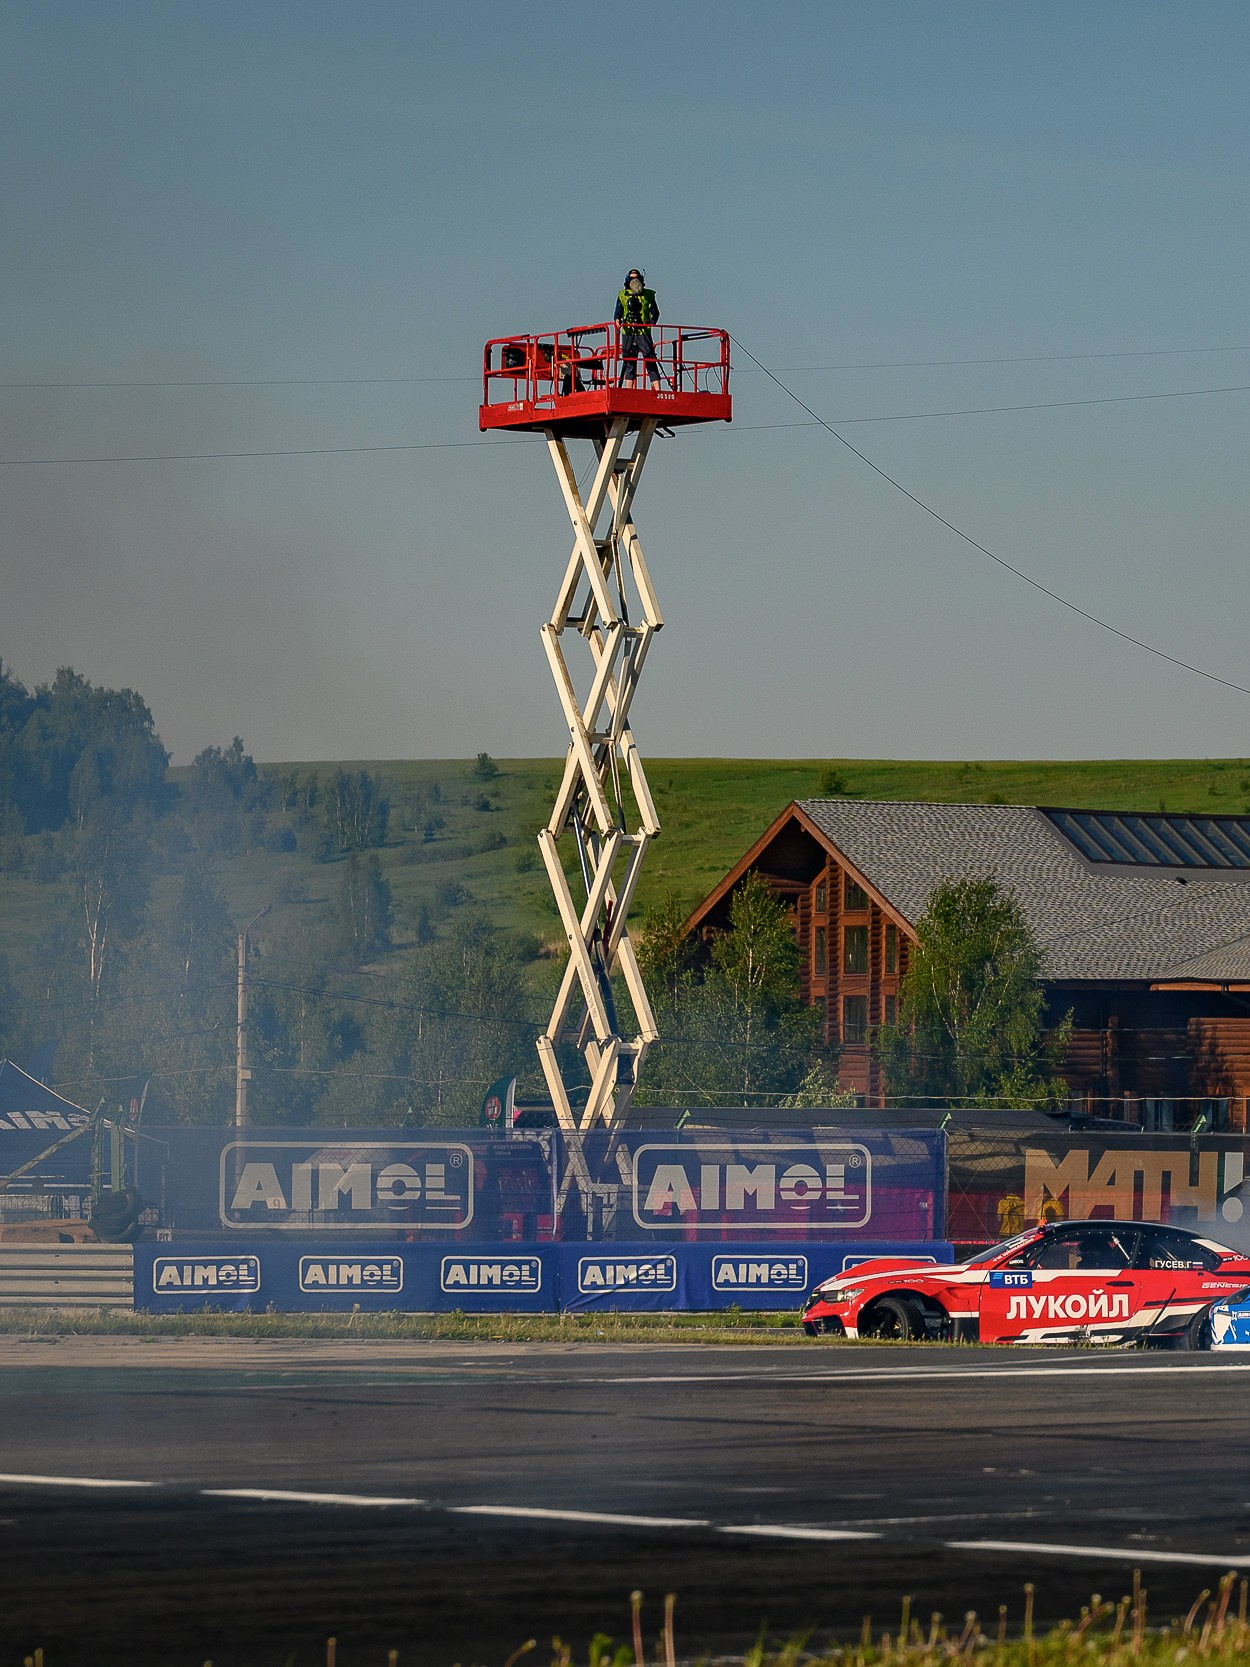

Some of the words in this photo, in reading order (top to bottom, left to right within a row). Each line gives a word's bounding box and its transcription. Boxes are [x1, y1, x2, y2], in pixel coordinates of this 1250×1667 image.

[230, 1162, 462, 1211] AIMOL
[643, 1163, 861, 1211] AIMOL
[158, 1264, 256, 1286] AIMOL
[303, 1264, 398, 1286] AIMOL
[445, 1264, 536, 1286] AIMOL
[582, 1264, 672, 1286] AIMOL
[715, 1263, 803, 1285] AIMOL
[1154, 1260, 1193, 1269] ГУСЕВ.Г
[1004, 1274, 1029, 1285] ВТБ
[1006, 1288, 1130, 1320] ЛУКОЙЛ
